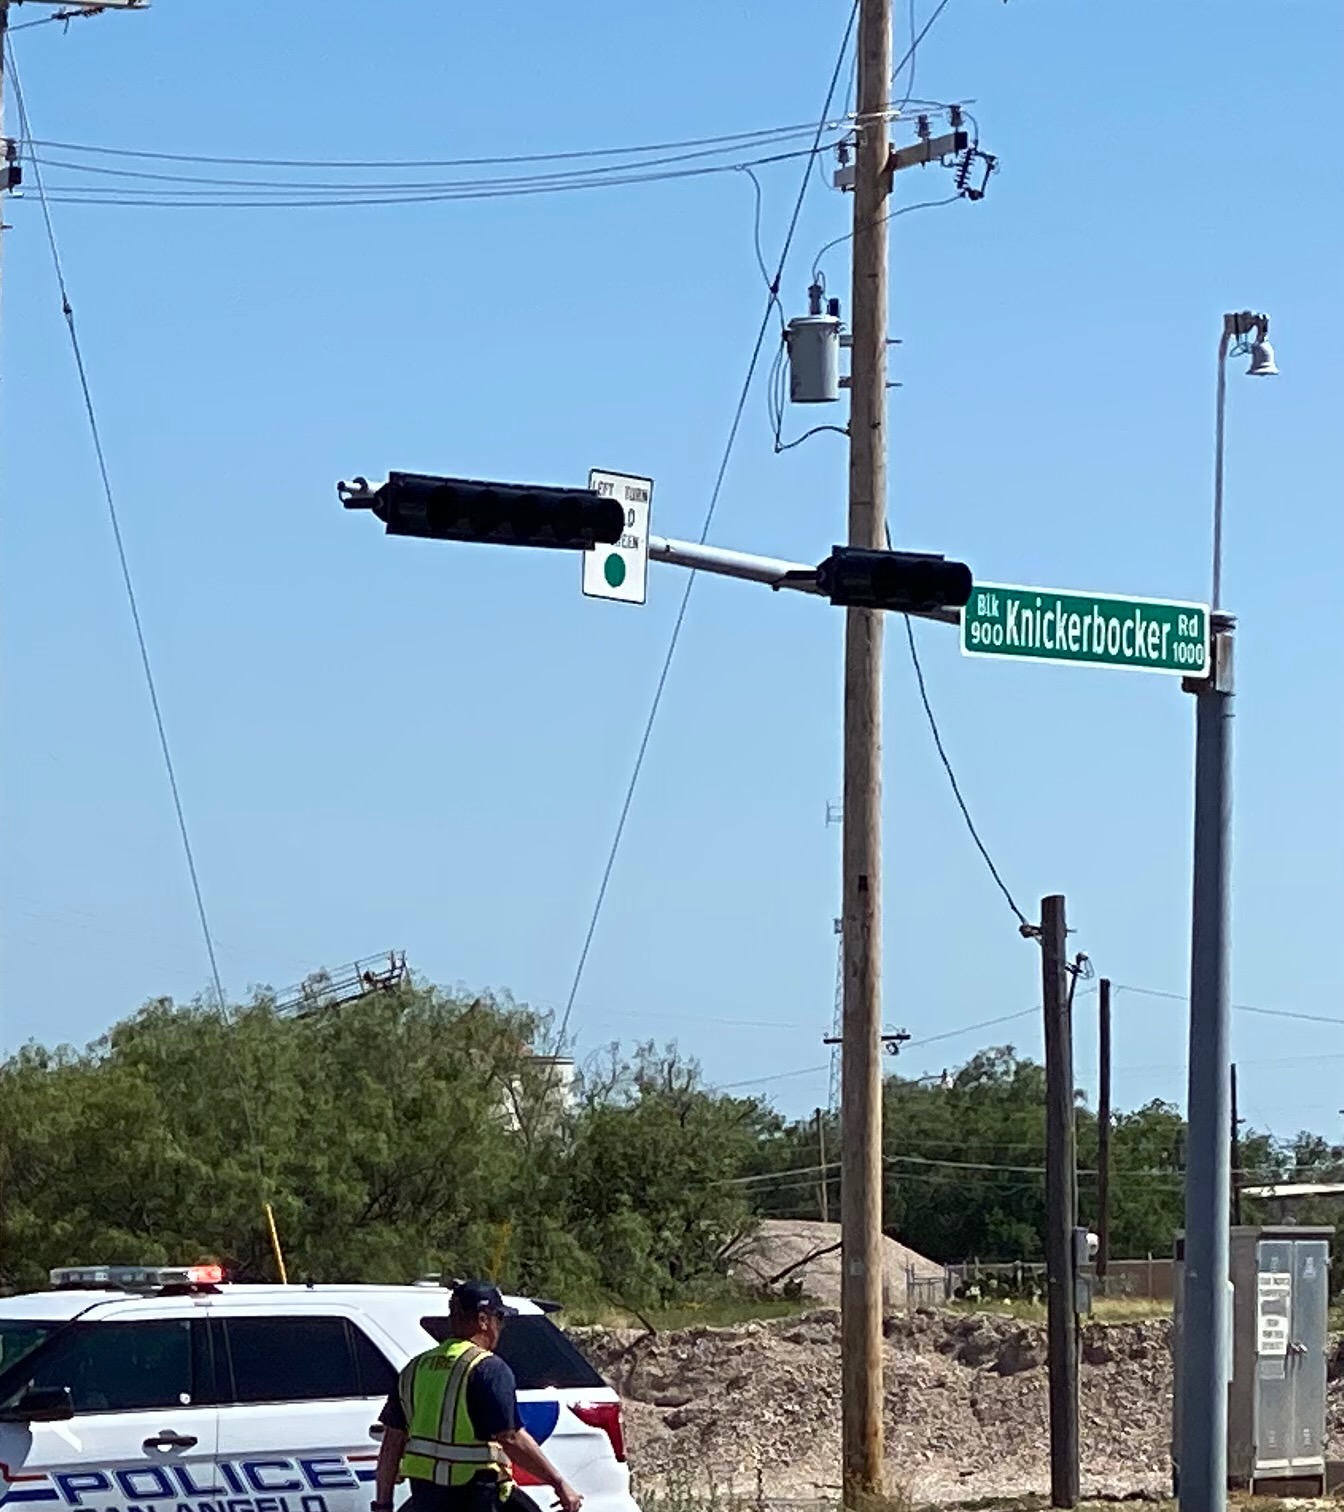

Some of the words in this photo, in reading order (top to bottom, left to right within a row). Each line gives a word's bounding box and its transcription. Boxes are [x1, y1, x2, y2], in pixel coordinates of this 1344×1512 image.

[977, 592, 1000, 617] Blk
[971, 621, 1004, 646] 900
[1005, 597, 1171, 660] Knickerbocker
[1177, 614, 1198, 637] Rd
[1173, 641, 1204, 665] 1000
[51, 1455, 360, 1506] POLICE
